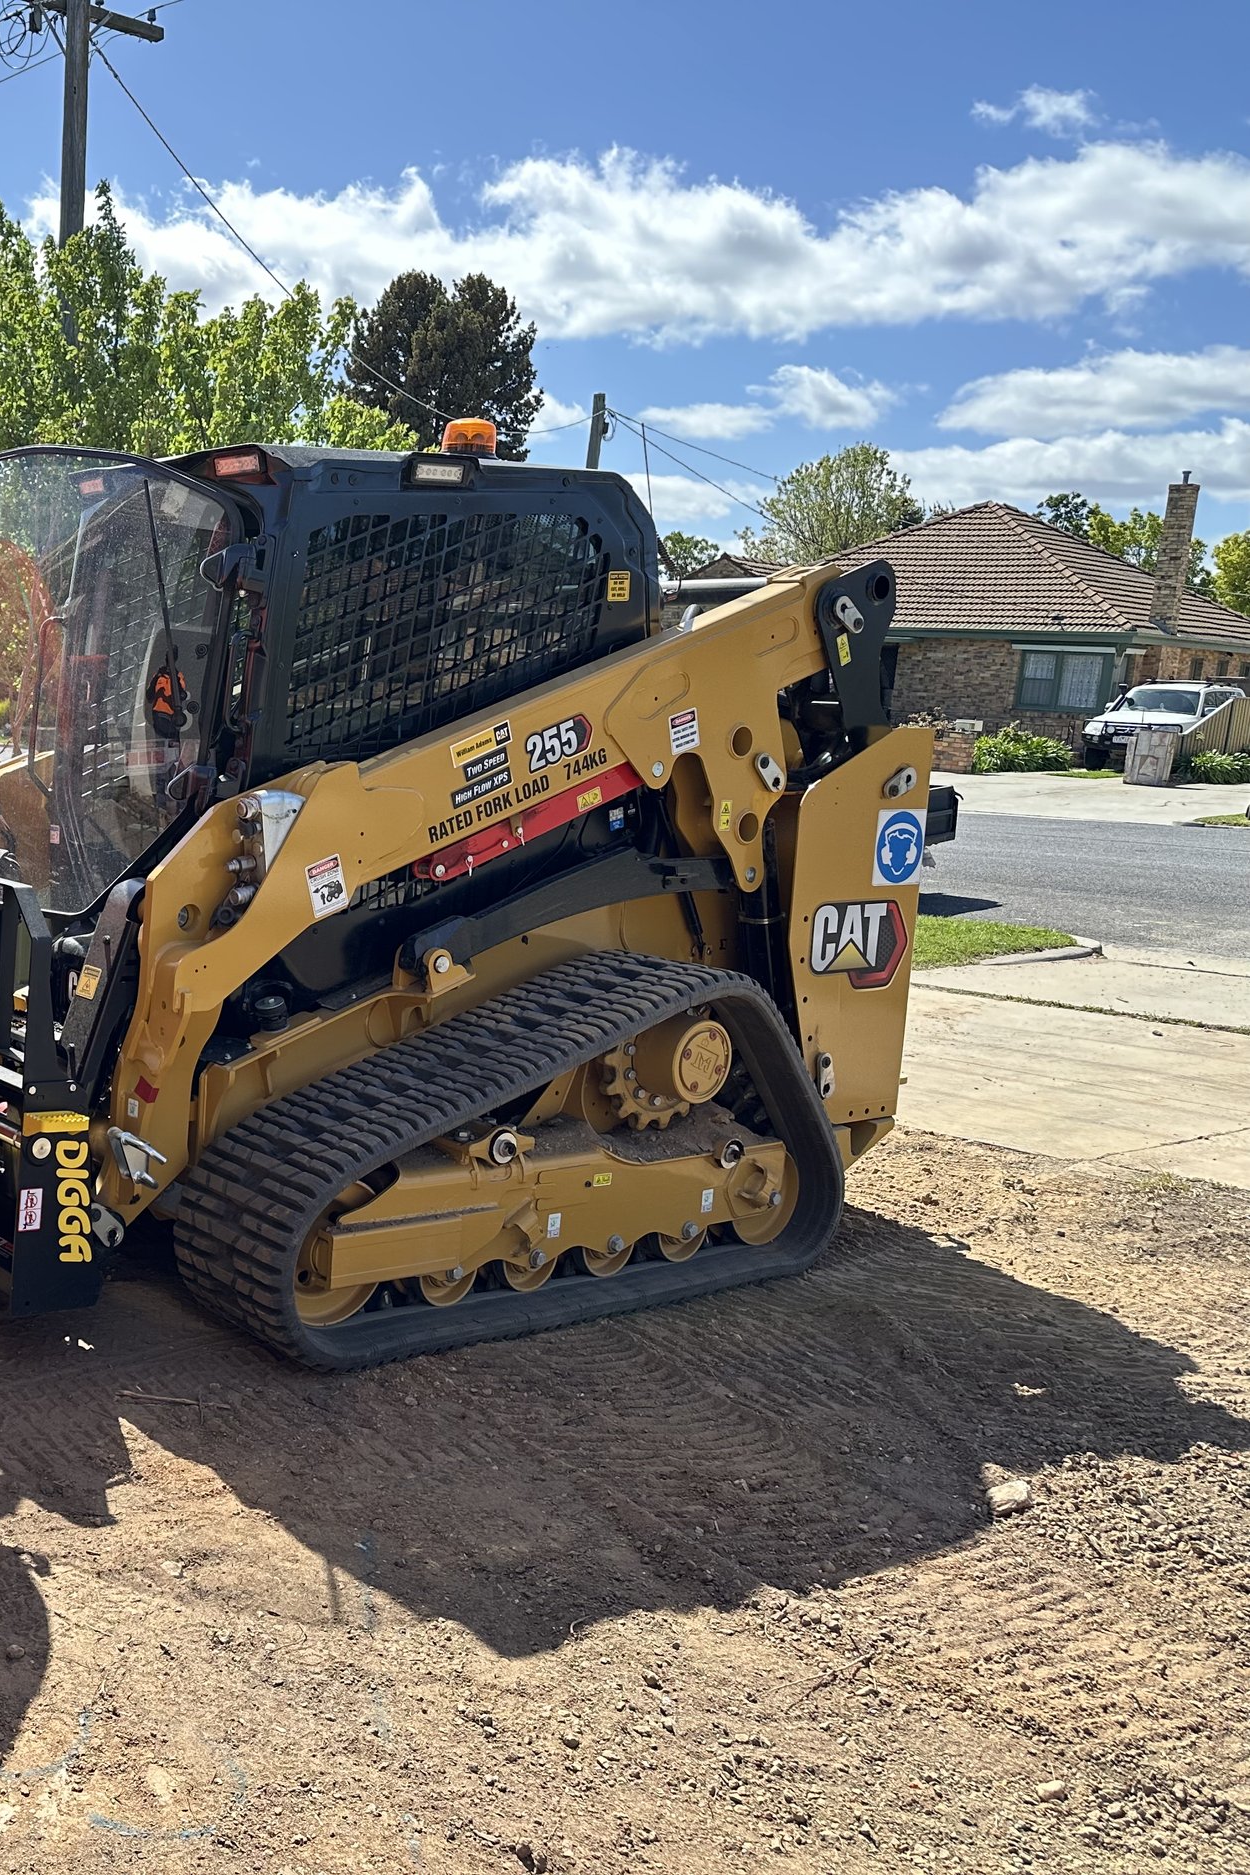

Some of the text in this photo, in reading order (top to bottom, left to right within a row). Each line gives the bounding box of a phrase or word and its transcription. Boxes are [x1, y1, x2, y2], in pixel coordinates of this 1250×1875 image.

[476, 738, 492, 749] Adams
[496, 727, 508, 741] CAT
[526, 719, 578, 771] 255
[455, 771, 508, 805] HIGH FLOW XPS
[467, 753, 505, 778] TWO SPEED
[428, 748, 607, 844] RATED FORK LOAD 744KG
[811, 902, 888, 973] CAT
[55, 1139, 93, 1263] DIGGA
